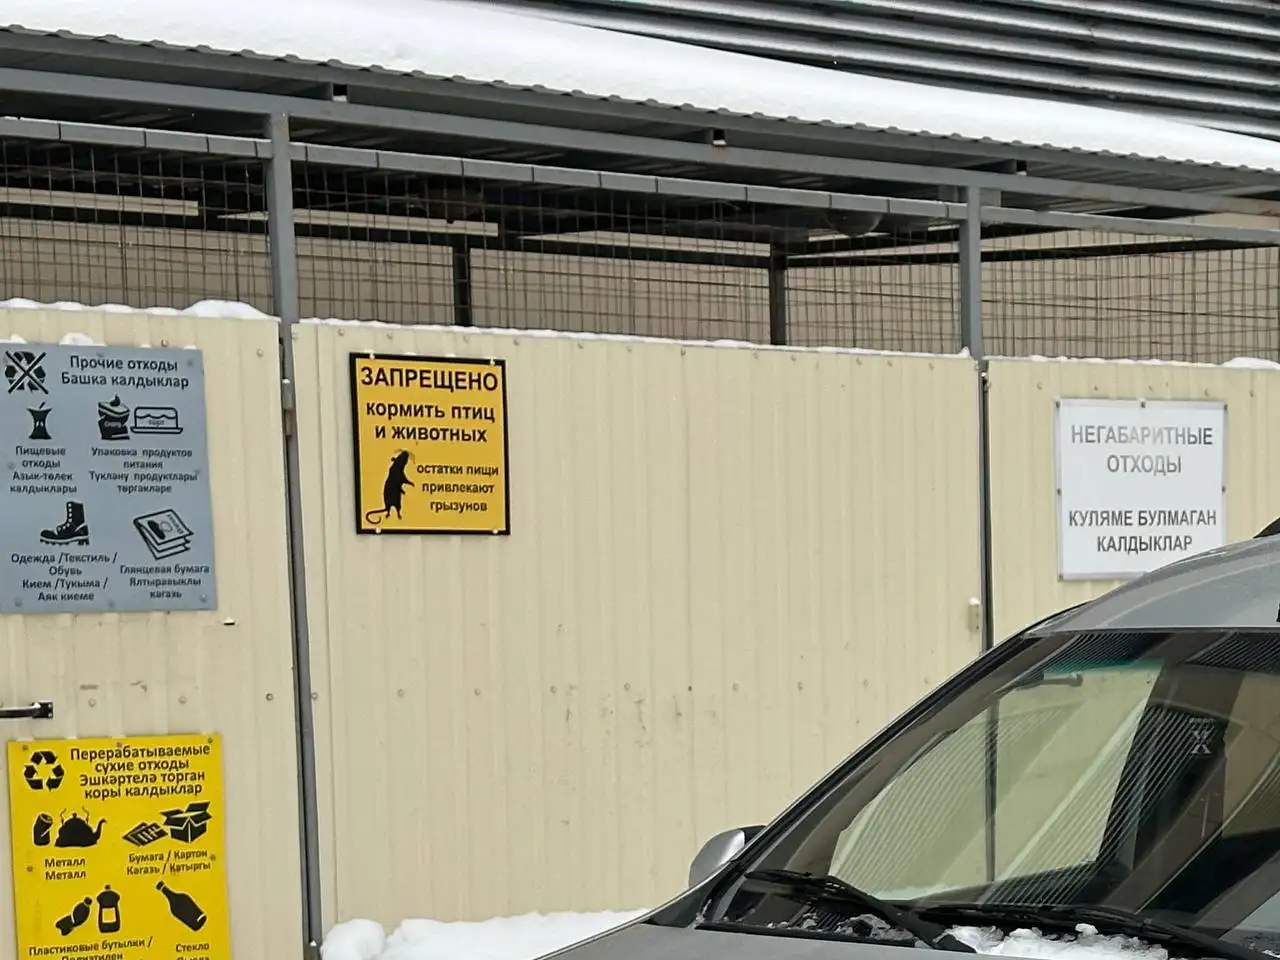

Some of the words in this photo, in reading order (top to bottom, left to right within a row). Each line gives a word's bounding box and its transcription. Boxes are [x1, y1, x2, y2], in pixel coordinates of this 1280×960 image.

[70, 355, 124, 371] Прочие
[128, 359, 179, 372] отходы
[61, 372, 107, 386] Башка
[111, 375, 189, 390] калдыклар
[361, 366, 498, 393] ЗАПРЕЩЕНО
[366, 402, 445, 420] кормить
[451, 406, 496, 423] птиц
[375, 426, 386, 439] и
[392, 426, 488, 442] животных
[1071, 425, 1213, 445] НЕГАБАРИТНЫЕ
[15, 446, 66, 458] Пищевые
[91, 447, 138, 458] Упаковка
[142, 448, 193, 459] продуктов
[22, 459, 61, 469] отходы
[123, 460, 163, 470] питания
[417, 464, 463, 475] остатки
[466, 466, 499, 478] пищи
[1107, 455, 1182, 476] ОТХОДЫ
[134, 472, 198, 483] продуктлары
[422, 483, 495, 495] привлекают
[430, 501, 488, 514] грызунов
[1069, 510, 1133, 526] КУЛЯМЕ
[1138, 510, 1217, 526] БУЛМАГАН
[1097, 535, 1193, 555] КАЛДЫКЛАР
[11, 554, 55, 565] Одежда
[49, 565, 82, 578] Обувь
[120, 565, 171, 577] Глянцевая
[175, 565, 210, 576] бумага
[22, 579, 51, 589] Кием
[38, 592, 58, 601] Аяк
[61, 592, 94, 601] киеме
[70, 745, 210, 762] Перерабатываемые
[95, 761, 134, 775] сухие
[138, 759, 189, 772] отходы
[161, 771, 205, 785] торган
[85, 787, 121, 801] коры
[125, 784, 202, 798] калдыклар
[44, 858, 86, 868] Металл
[128, 853, 164, 864] Бумага
[174, 849, 208, 860] Картон
[45, 870, 86, 881] Металл
[29, 943, 99, 956] Пластиковые
[102, 939, 145, 951] бутылки
[175, 943, 210, 953] Стекло
